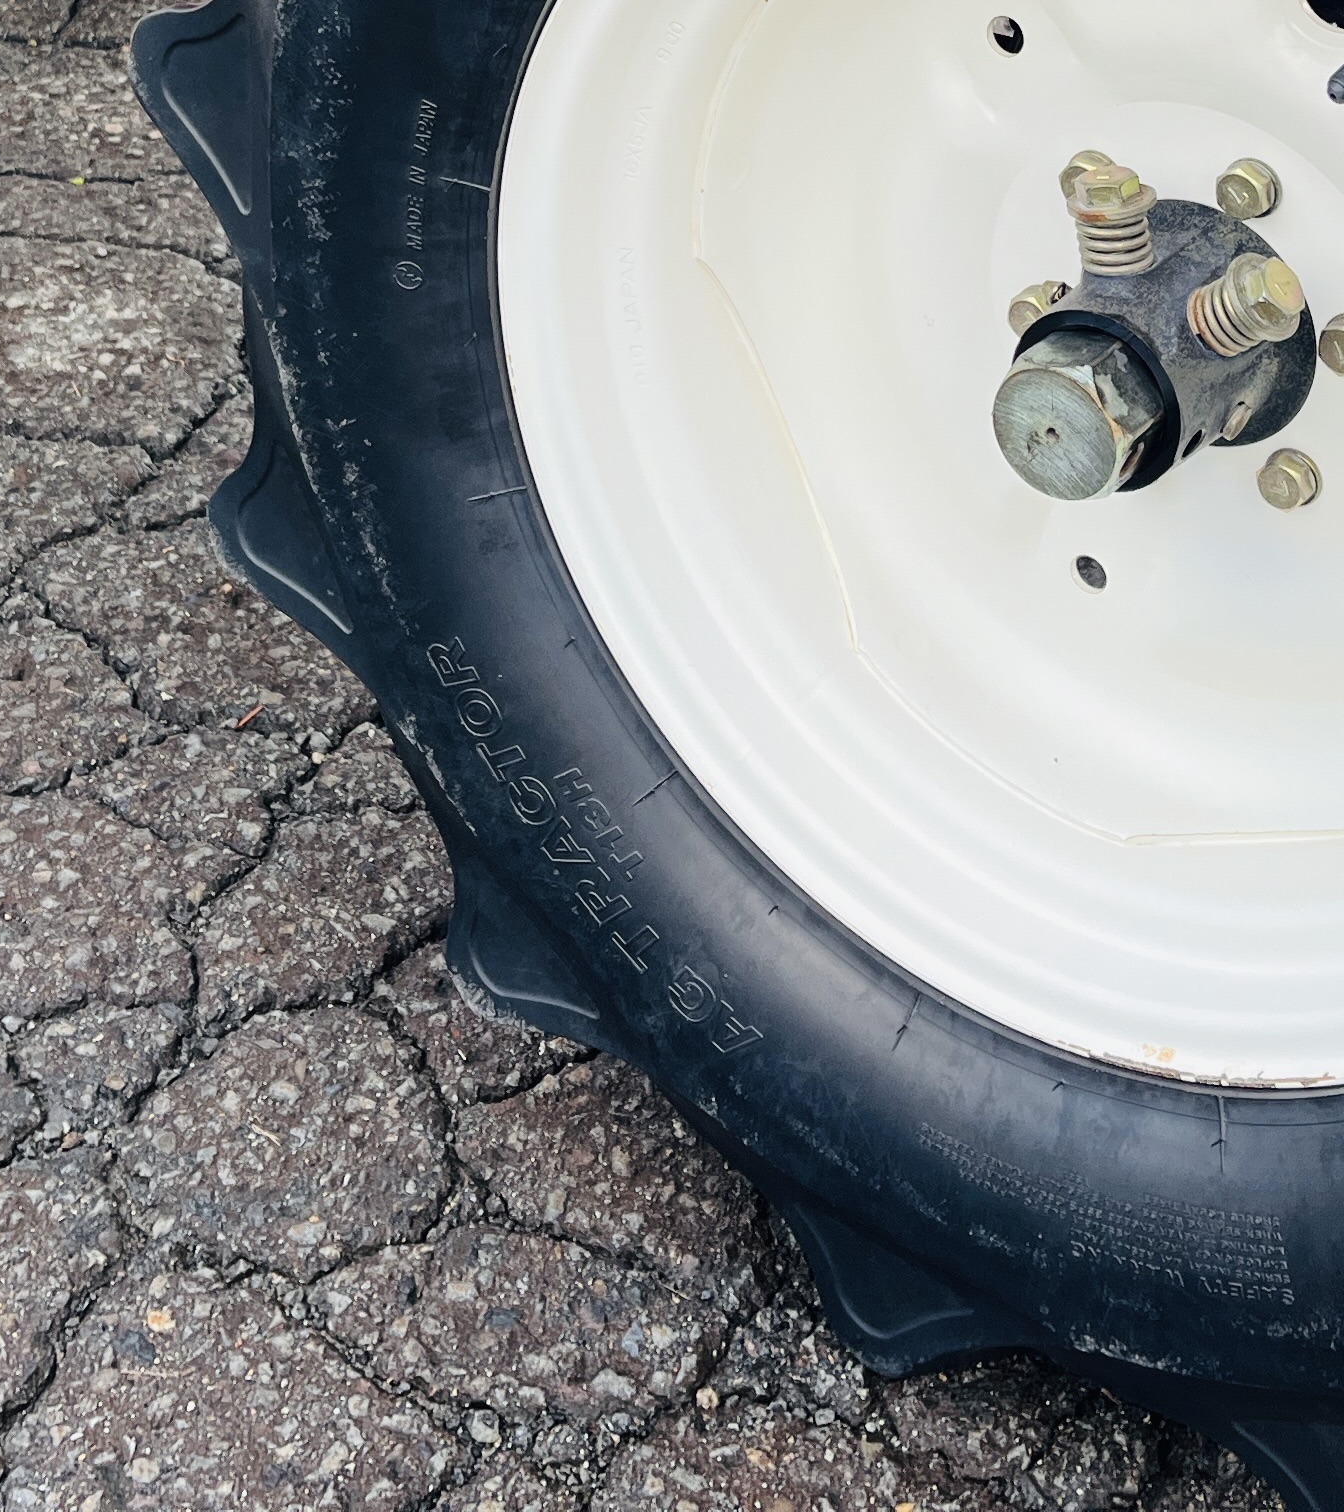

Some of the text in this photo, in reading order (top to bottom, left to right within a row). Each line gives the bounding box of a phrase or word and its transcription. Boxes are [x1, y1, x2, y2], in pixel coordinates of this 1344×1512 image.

[406, 99, 438, 251] MADE IN JAPAN
[617, 245, 644, 336] JAPAN
[426, 635, 765, 1055] AG TRACTOR
[553, 766, 645, 883] T13H
[1200, 1276, 1296, 1305] SAFETY
